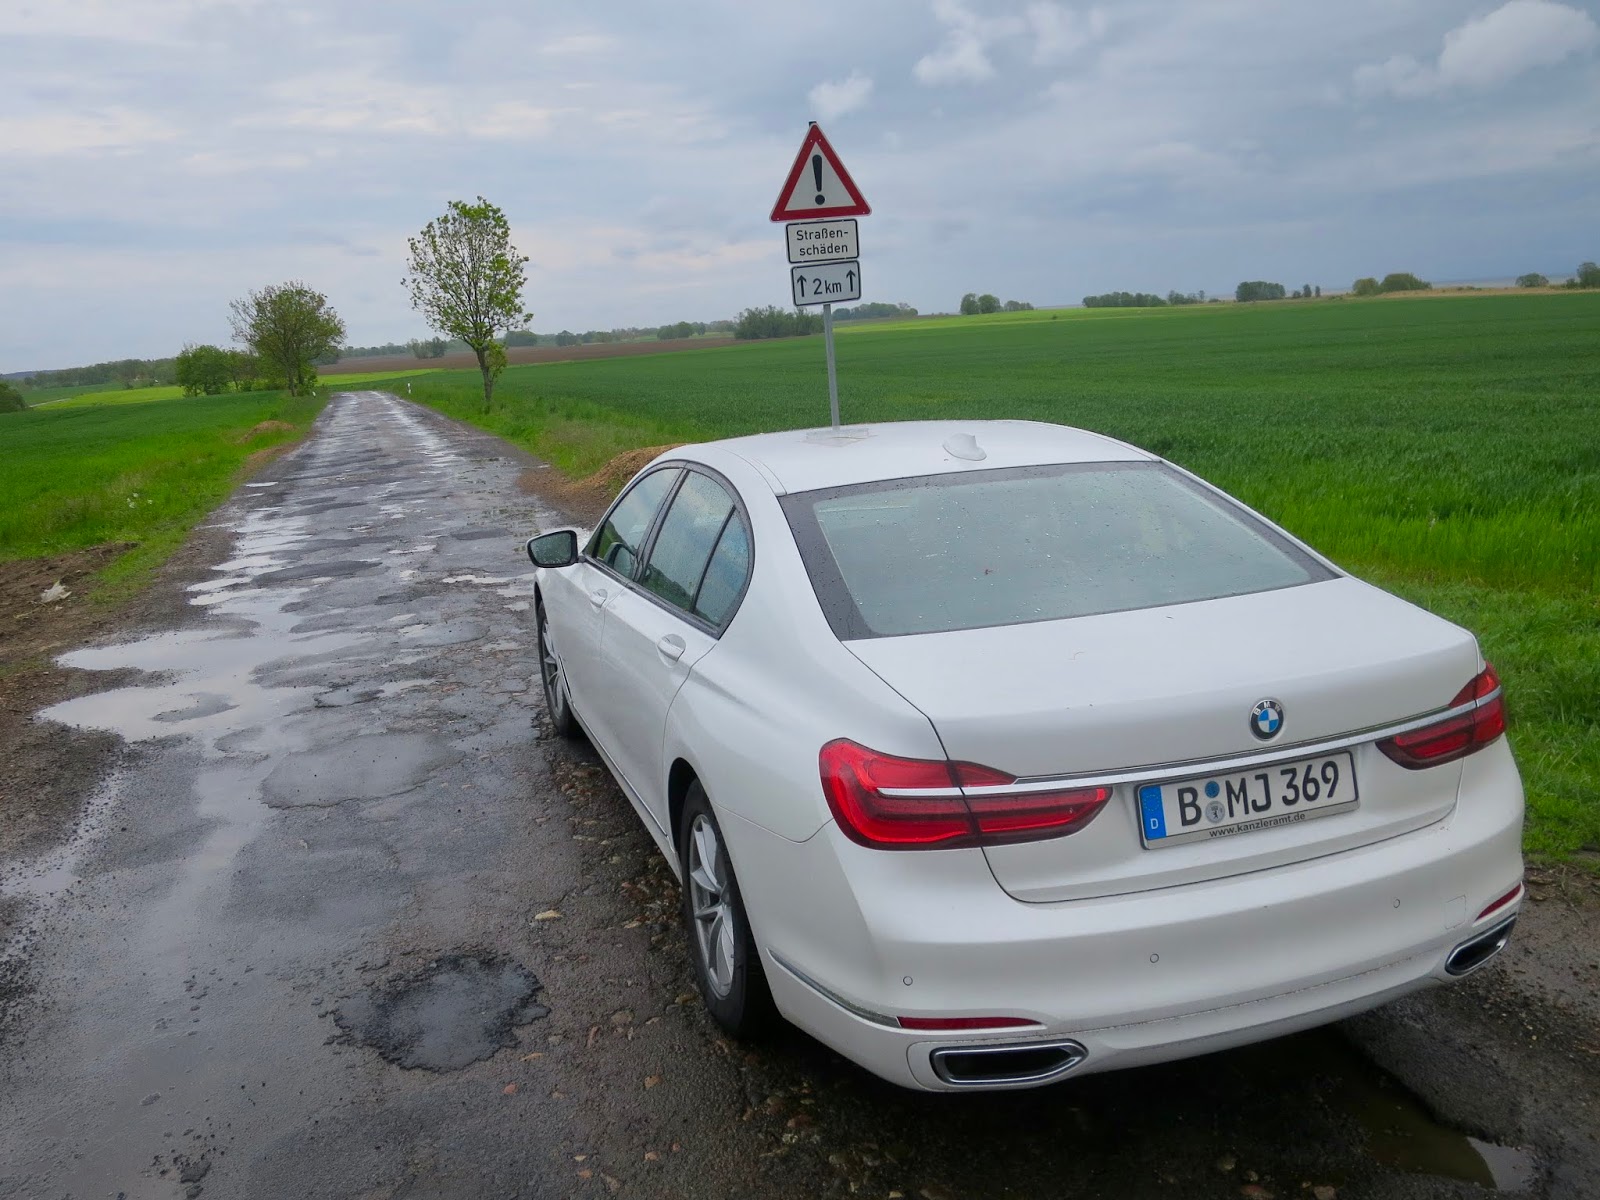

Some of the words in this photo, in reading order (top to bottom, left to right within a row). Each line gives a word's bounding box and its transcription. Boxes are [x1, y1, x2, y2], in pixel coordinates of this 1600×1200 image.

[796, 227, 849, 241] Straßen-
[799, 243, 848, 256] schäden
[812, 278, 823, 295] 2
[825, 280, 842, 294] km
[1177, 786, 1202, 827] B
[1225, 773, 1272, 818] MJ
[1280, 760, 1339, 807] 369
[1150, 818, 1159, 830] D
[1209, 812, 1306, 838] www.kanzleramt.de
